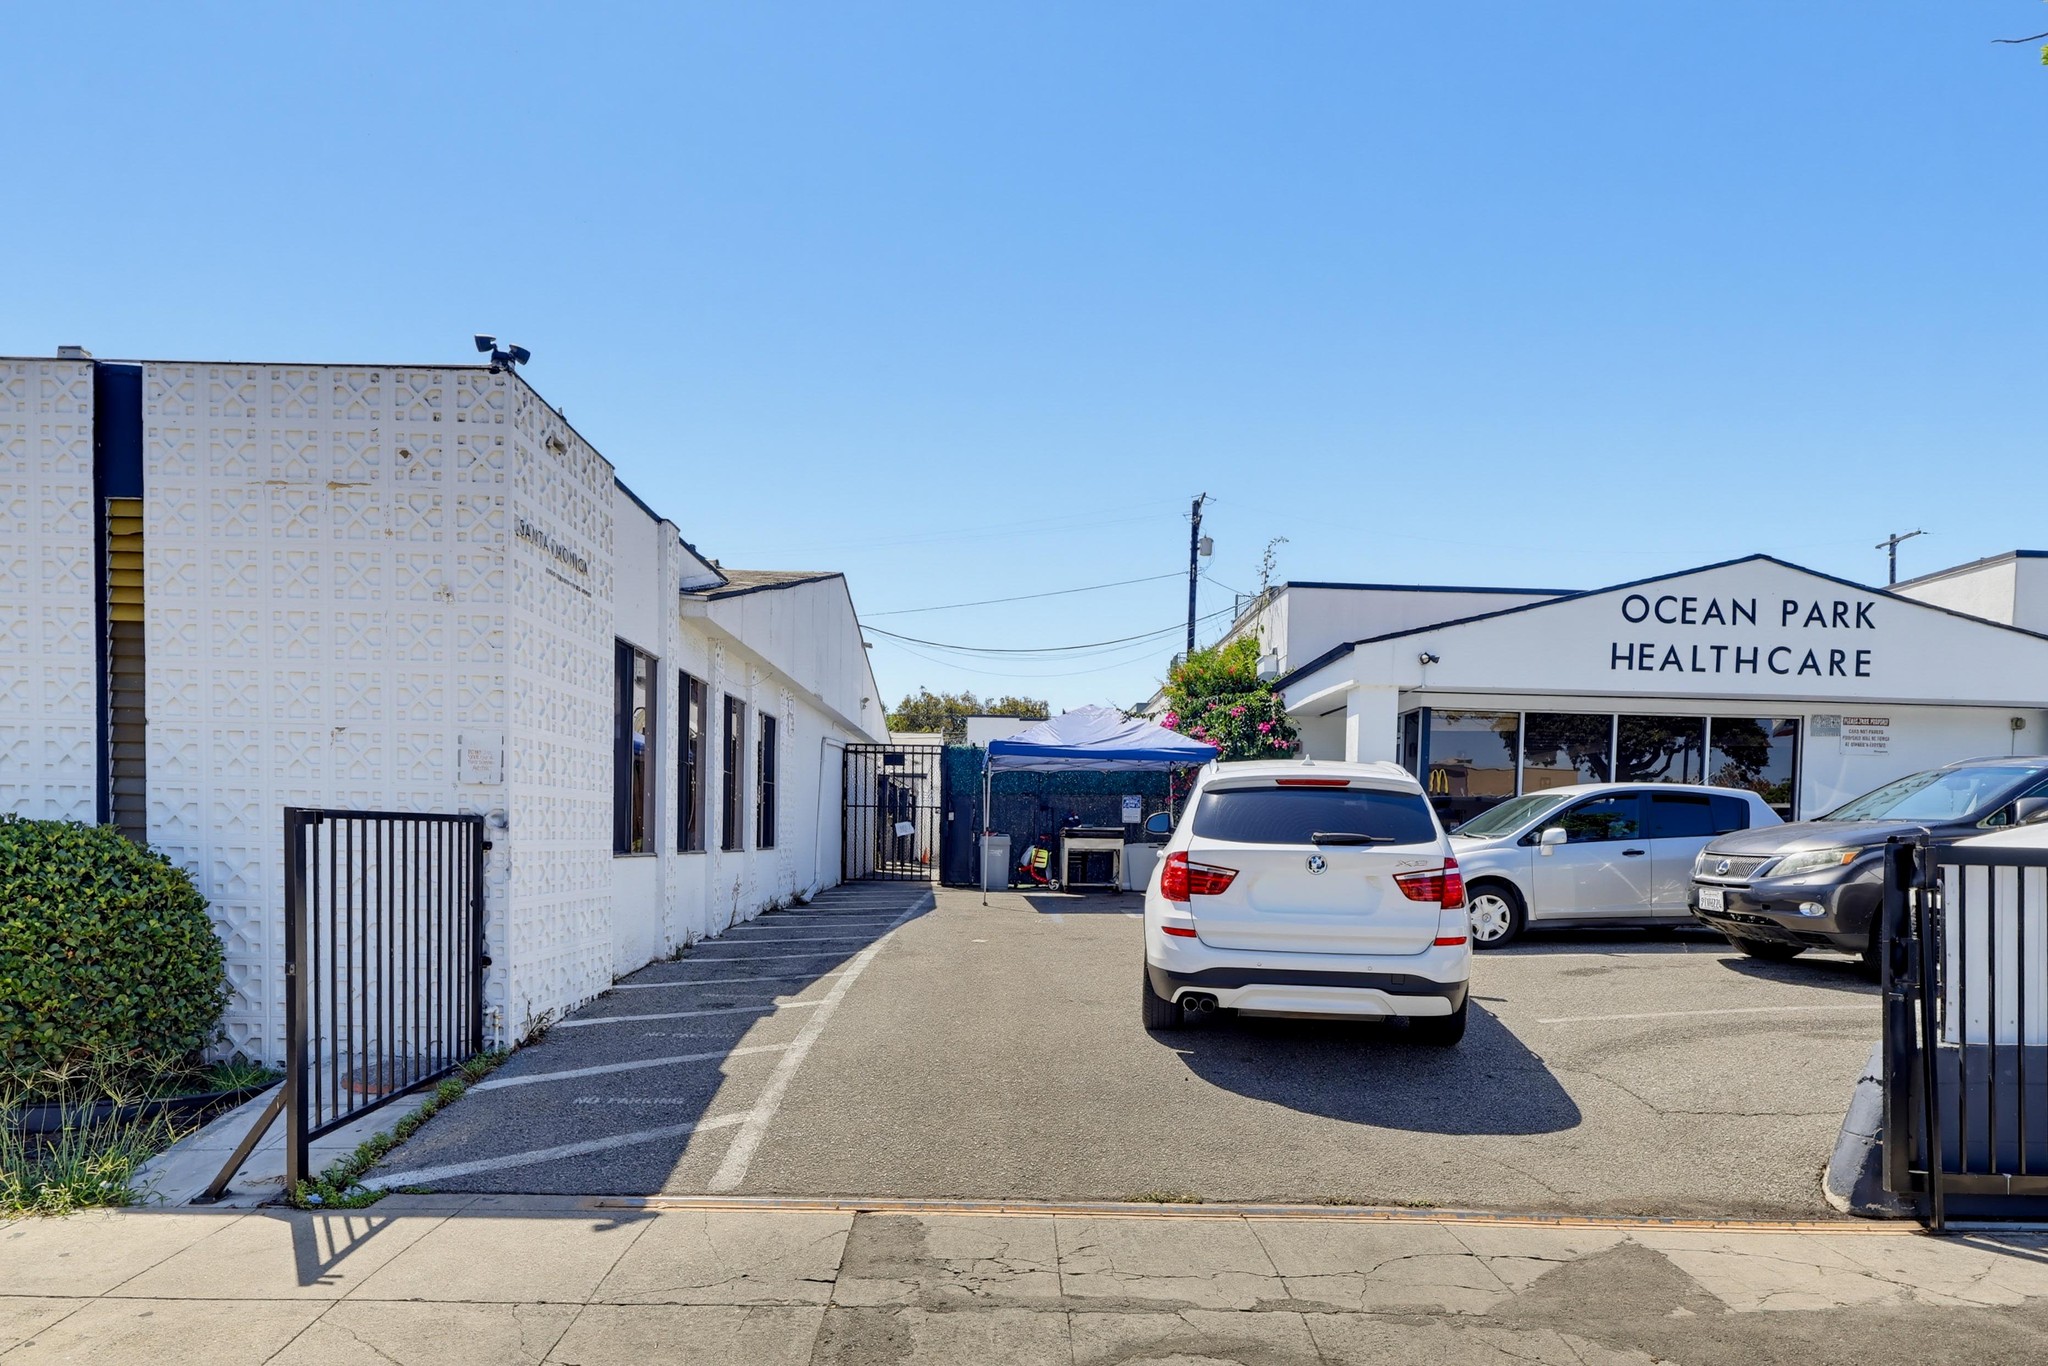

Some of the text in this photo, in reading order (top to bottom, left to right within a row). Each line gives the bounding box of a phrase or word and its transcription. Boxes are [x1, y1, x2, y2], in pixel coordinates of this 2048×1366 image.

[516, 519, 588, 575] SANTA MONICA
[1621, 594, 1876, 629] OCEAN PARK
[1610, 642, 1872, 677] HEALTHCARE
